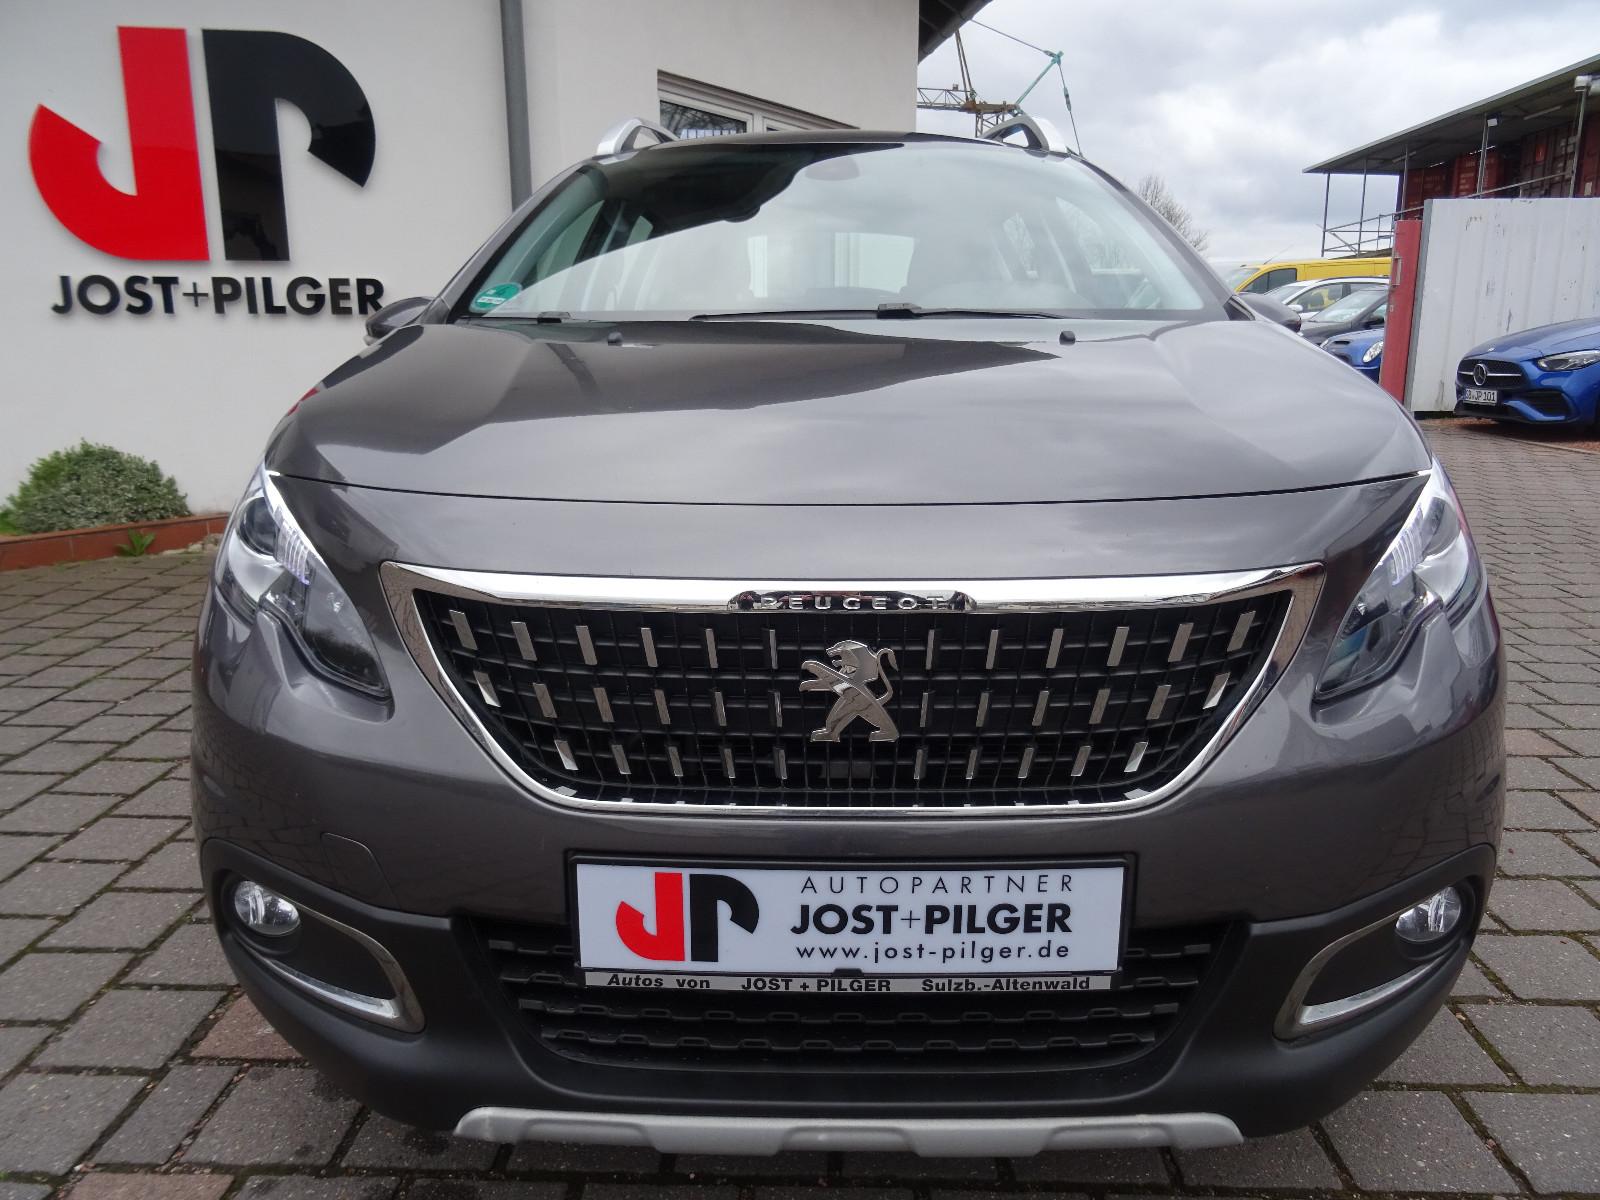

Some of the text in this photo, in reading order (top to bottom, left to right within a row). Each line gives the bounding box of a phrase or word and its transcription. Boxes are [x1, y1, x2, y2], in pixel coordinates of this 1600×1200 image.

[760, 595, 945, 610] PEUGEOT
[800, 874, 1073, 894] AUTOPARTNER
[790, 903, 1073, 935] JOST+PILGER
[796, 940, 1070, 963] www.jost-pilger.de
[607, 973, 664, 988] Autos
[676, 978, 711, 989] von
[741, 977, 793, 991] JOST
[816, 978, 892, 992] PILGER
[921, 976, 1090, 992] Sulzb.-Altenwald
